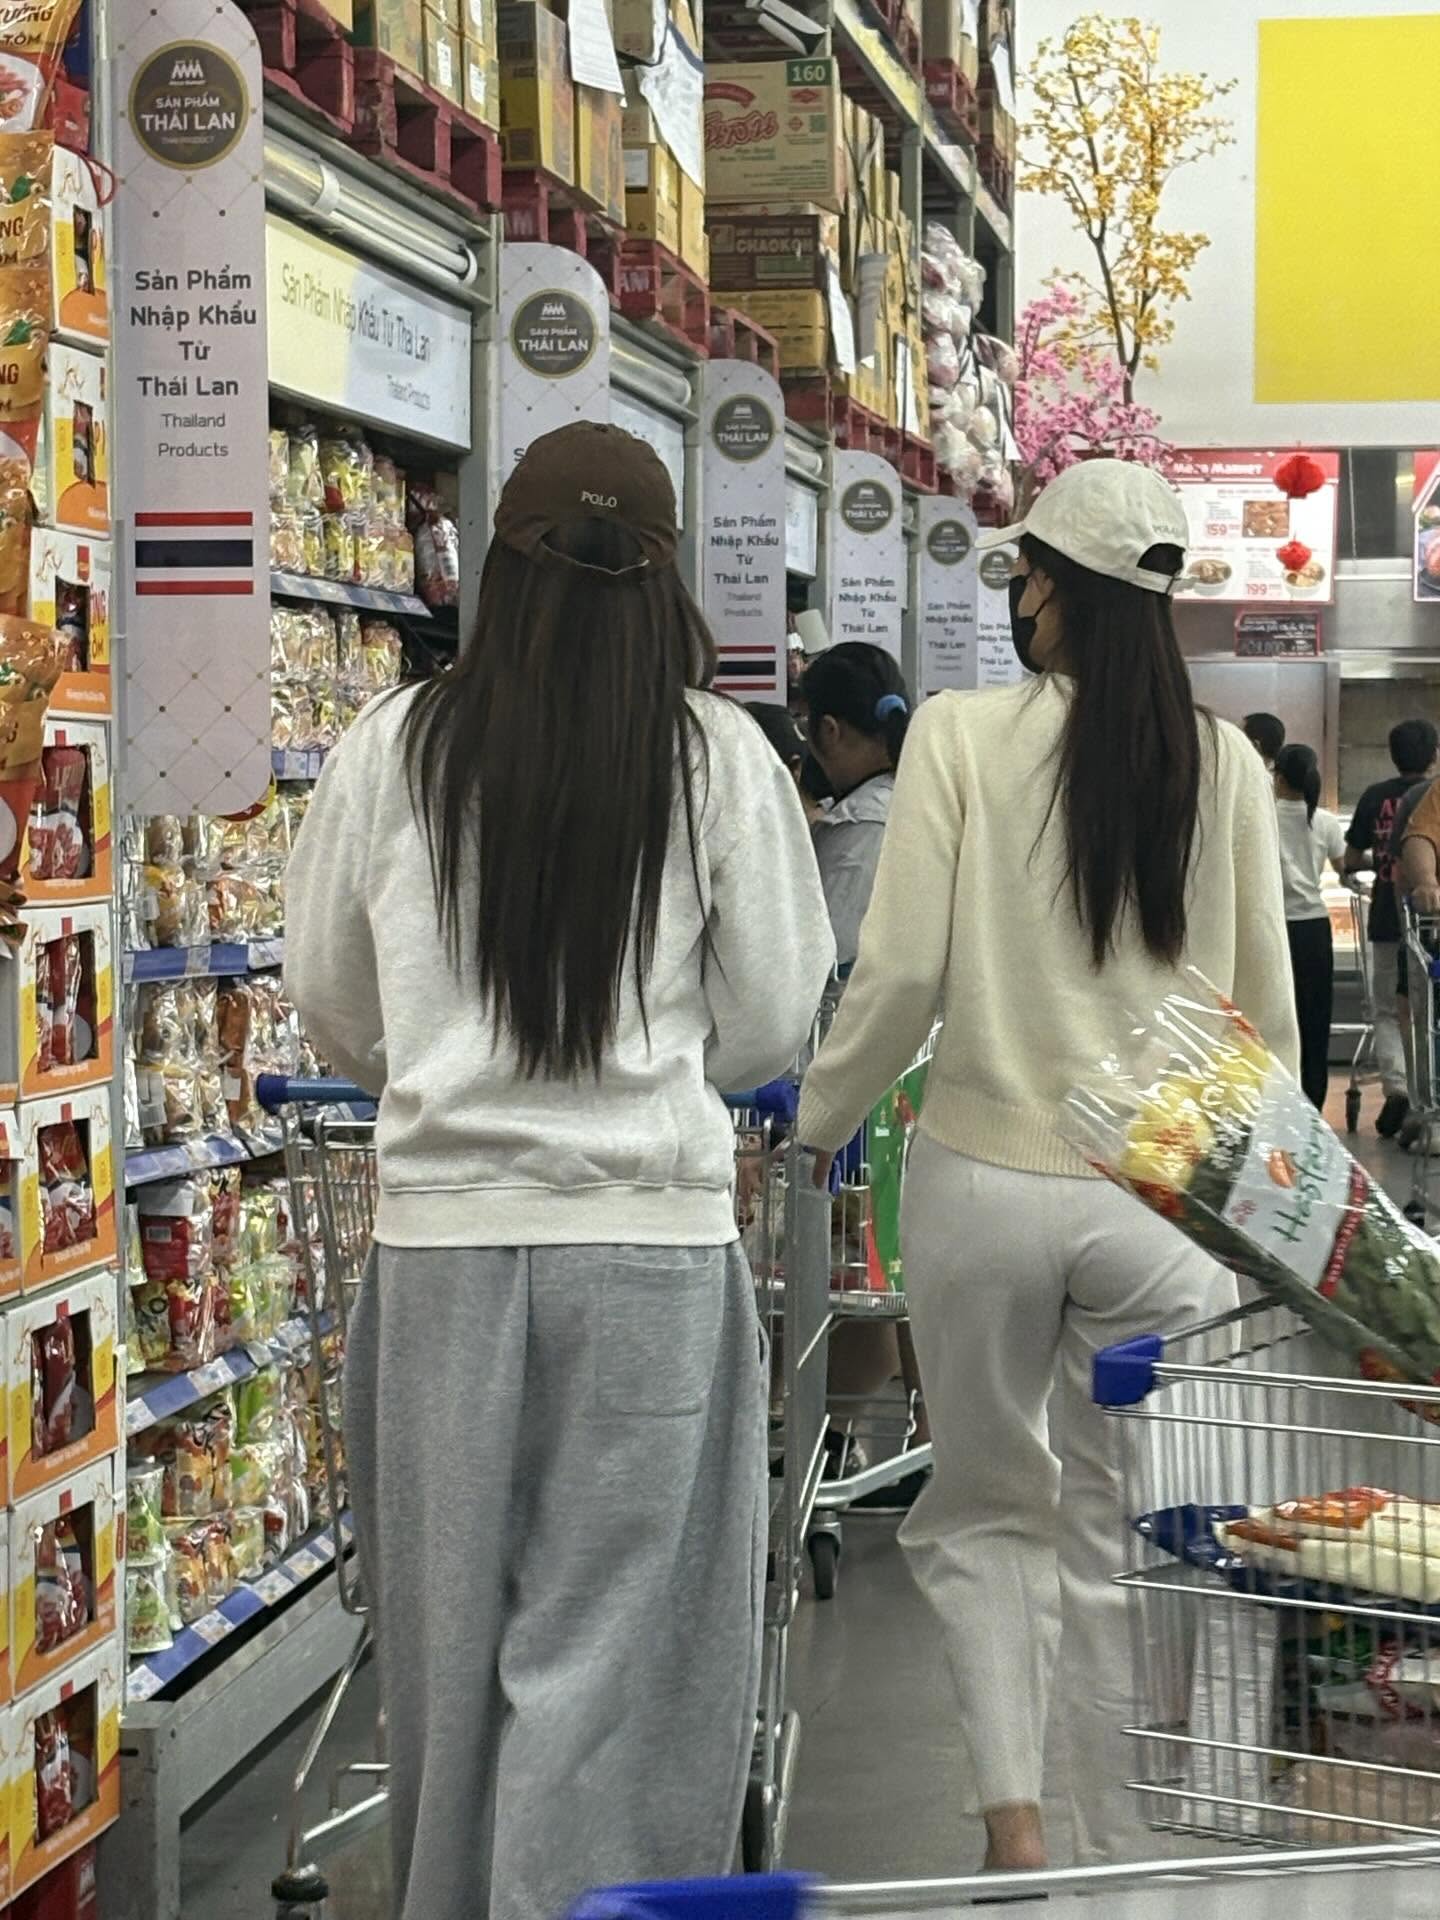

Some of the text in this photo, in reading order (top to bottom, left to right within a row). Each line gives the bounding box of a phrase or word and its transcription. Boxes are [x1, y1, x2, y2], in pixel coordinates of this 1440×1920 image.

[793, 65, 826, 82] 160
[155, 95, 181, 109] SẢN
[141, 110, 236, 131] THÁI LAN
[135, 265, 252, 291] Sản Phẩm
[130, 300, 256, 332] Nhập Khẩu
[178, 340, 211, 361] Từ
[519, 336, 589, 352] THÁI LAN
[137, 375, 239, 397] Thái Lan
[162, 413, 226, 428] Thailand
[158, 443, 229, 457] Products
[581, 490, 617, 508] POLO
[745, 573, 769, 584] Lan
